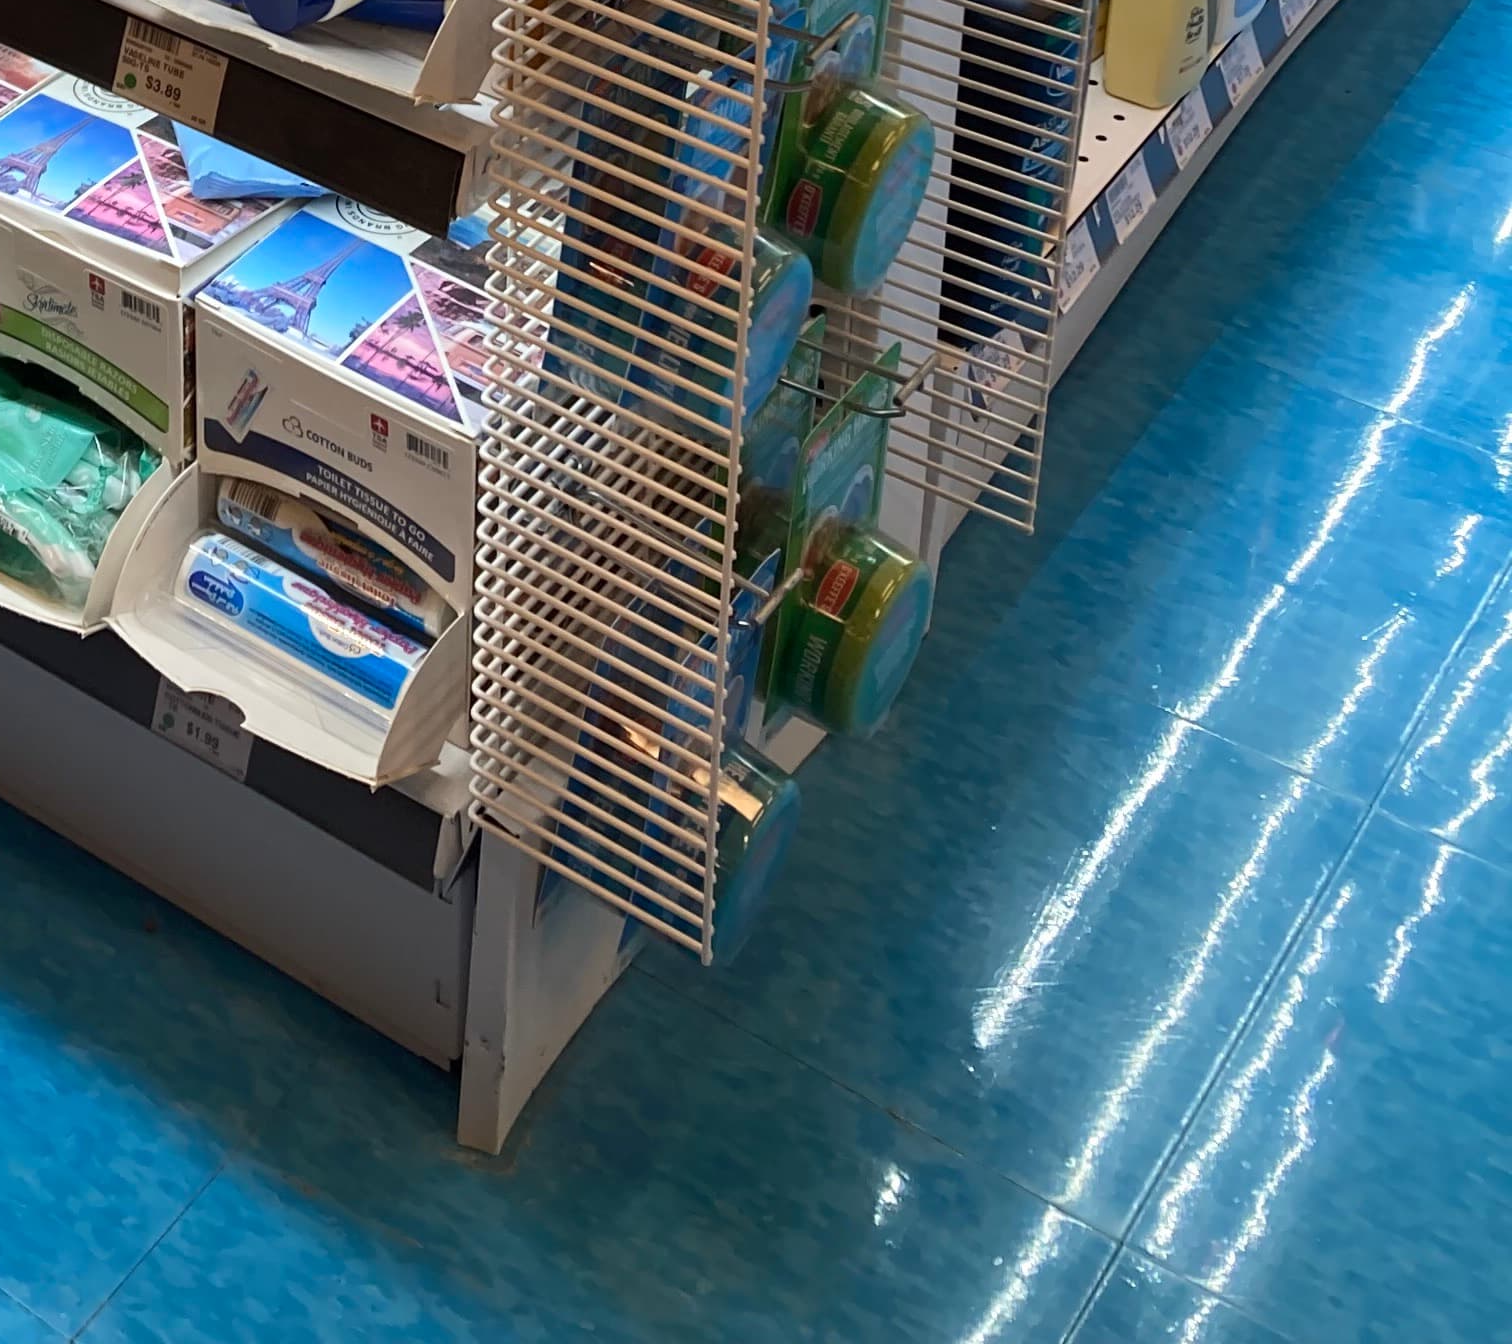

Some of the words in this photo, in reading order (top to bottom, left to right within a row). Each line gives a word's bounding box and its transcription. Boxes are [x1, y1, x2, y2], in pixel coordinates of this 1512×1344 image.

[145, 75, 181, 101] $3.89
[163, 63, 185, 79] TUBE
[306, 429, 345, 458] COTTON
[347, 452, 373, 473] BUDS
[306, 473, 337, 499] PAPIER
[408, 537, 434, 562] FAIRE
[317, 466, 353, 492] TOILET
[354, 486, 389, 514] TISSUE
[392, 512, 407, 528] TO
[408, 524, 426, 542] GO
